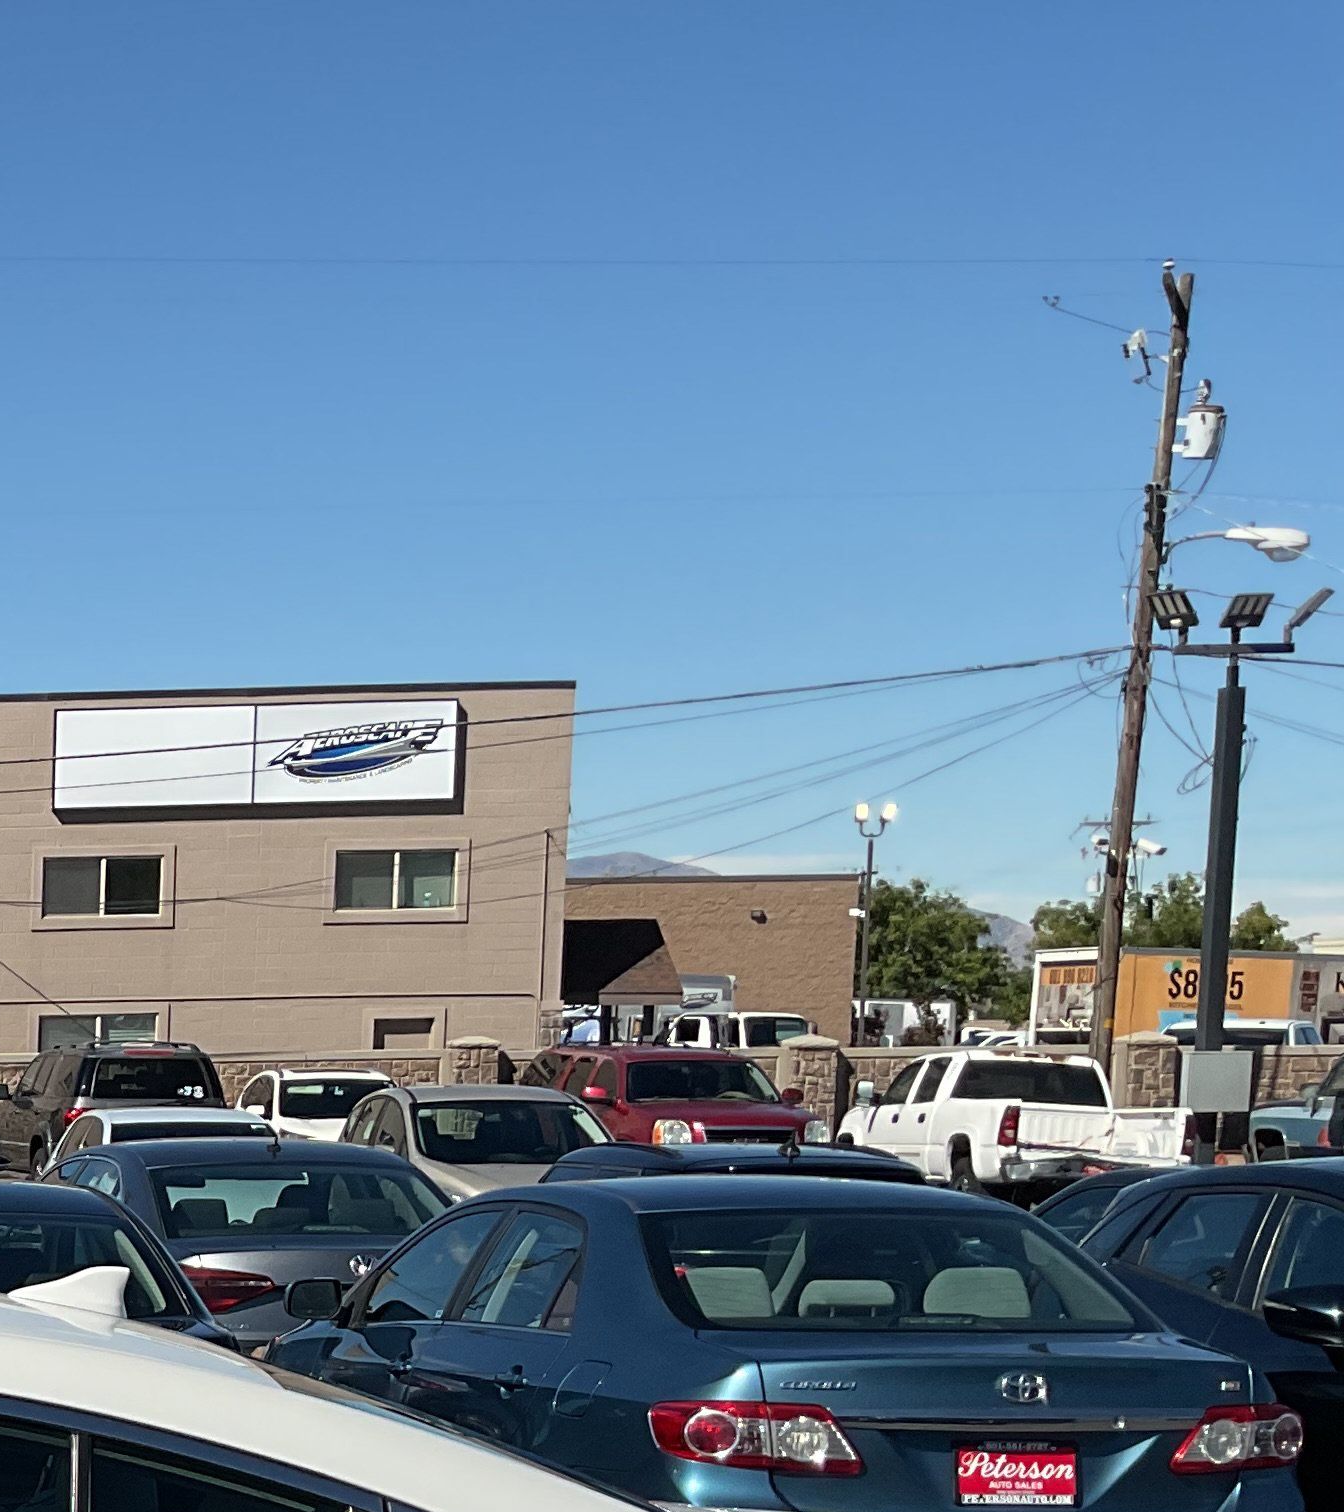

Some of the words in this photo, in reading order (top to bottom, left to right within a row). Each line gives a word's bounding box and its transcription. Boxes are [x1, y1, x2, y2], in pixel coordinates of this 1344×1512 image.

[265, 718, 444, 768] AEROSCAPE
[1168, 968, 1245, 1000] $85
[958, 1452, 1075, 1480] Peterson
[988, 1481, 1013, 1489] AUTO
[1014, 1481, 1044, 1489] SALES
